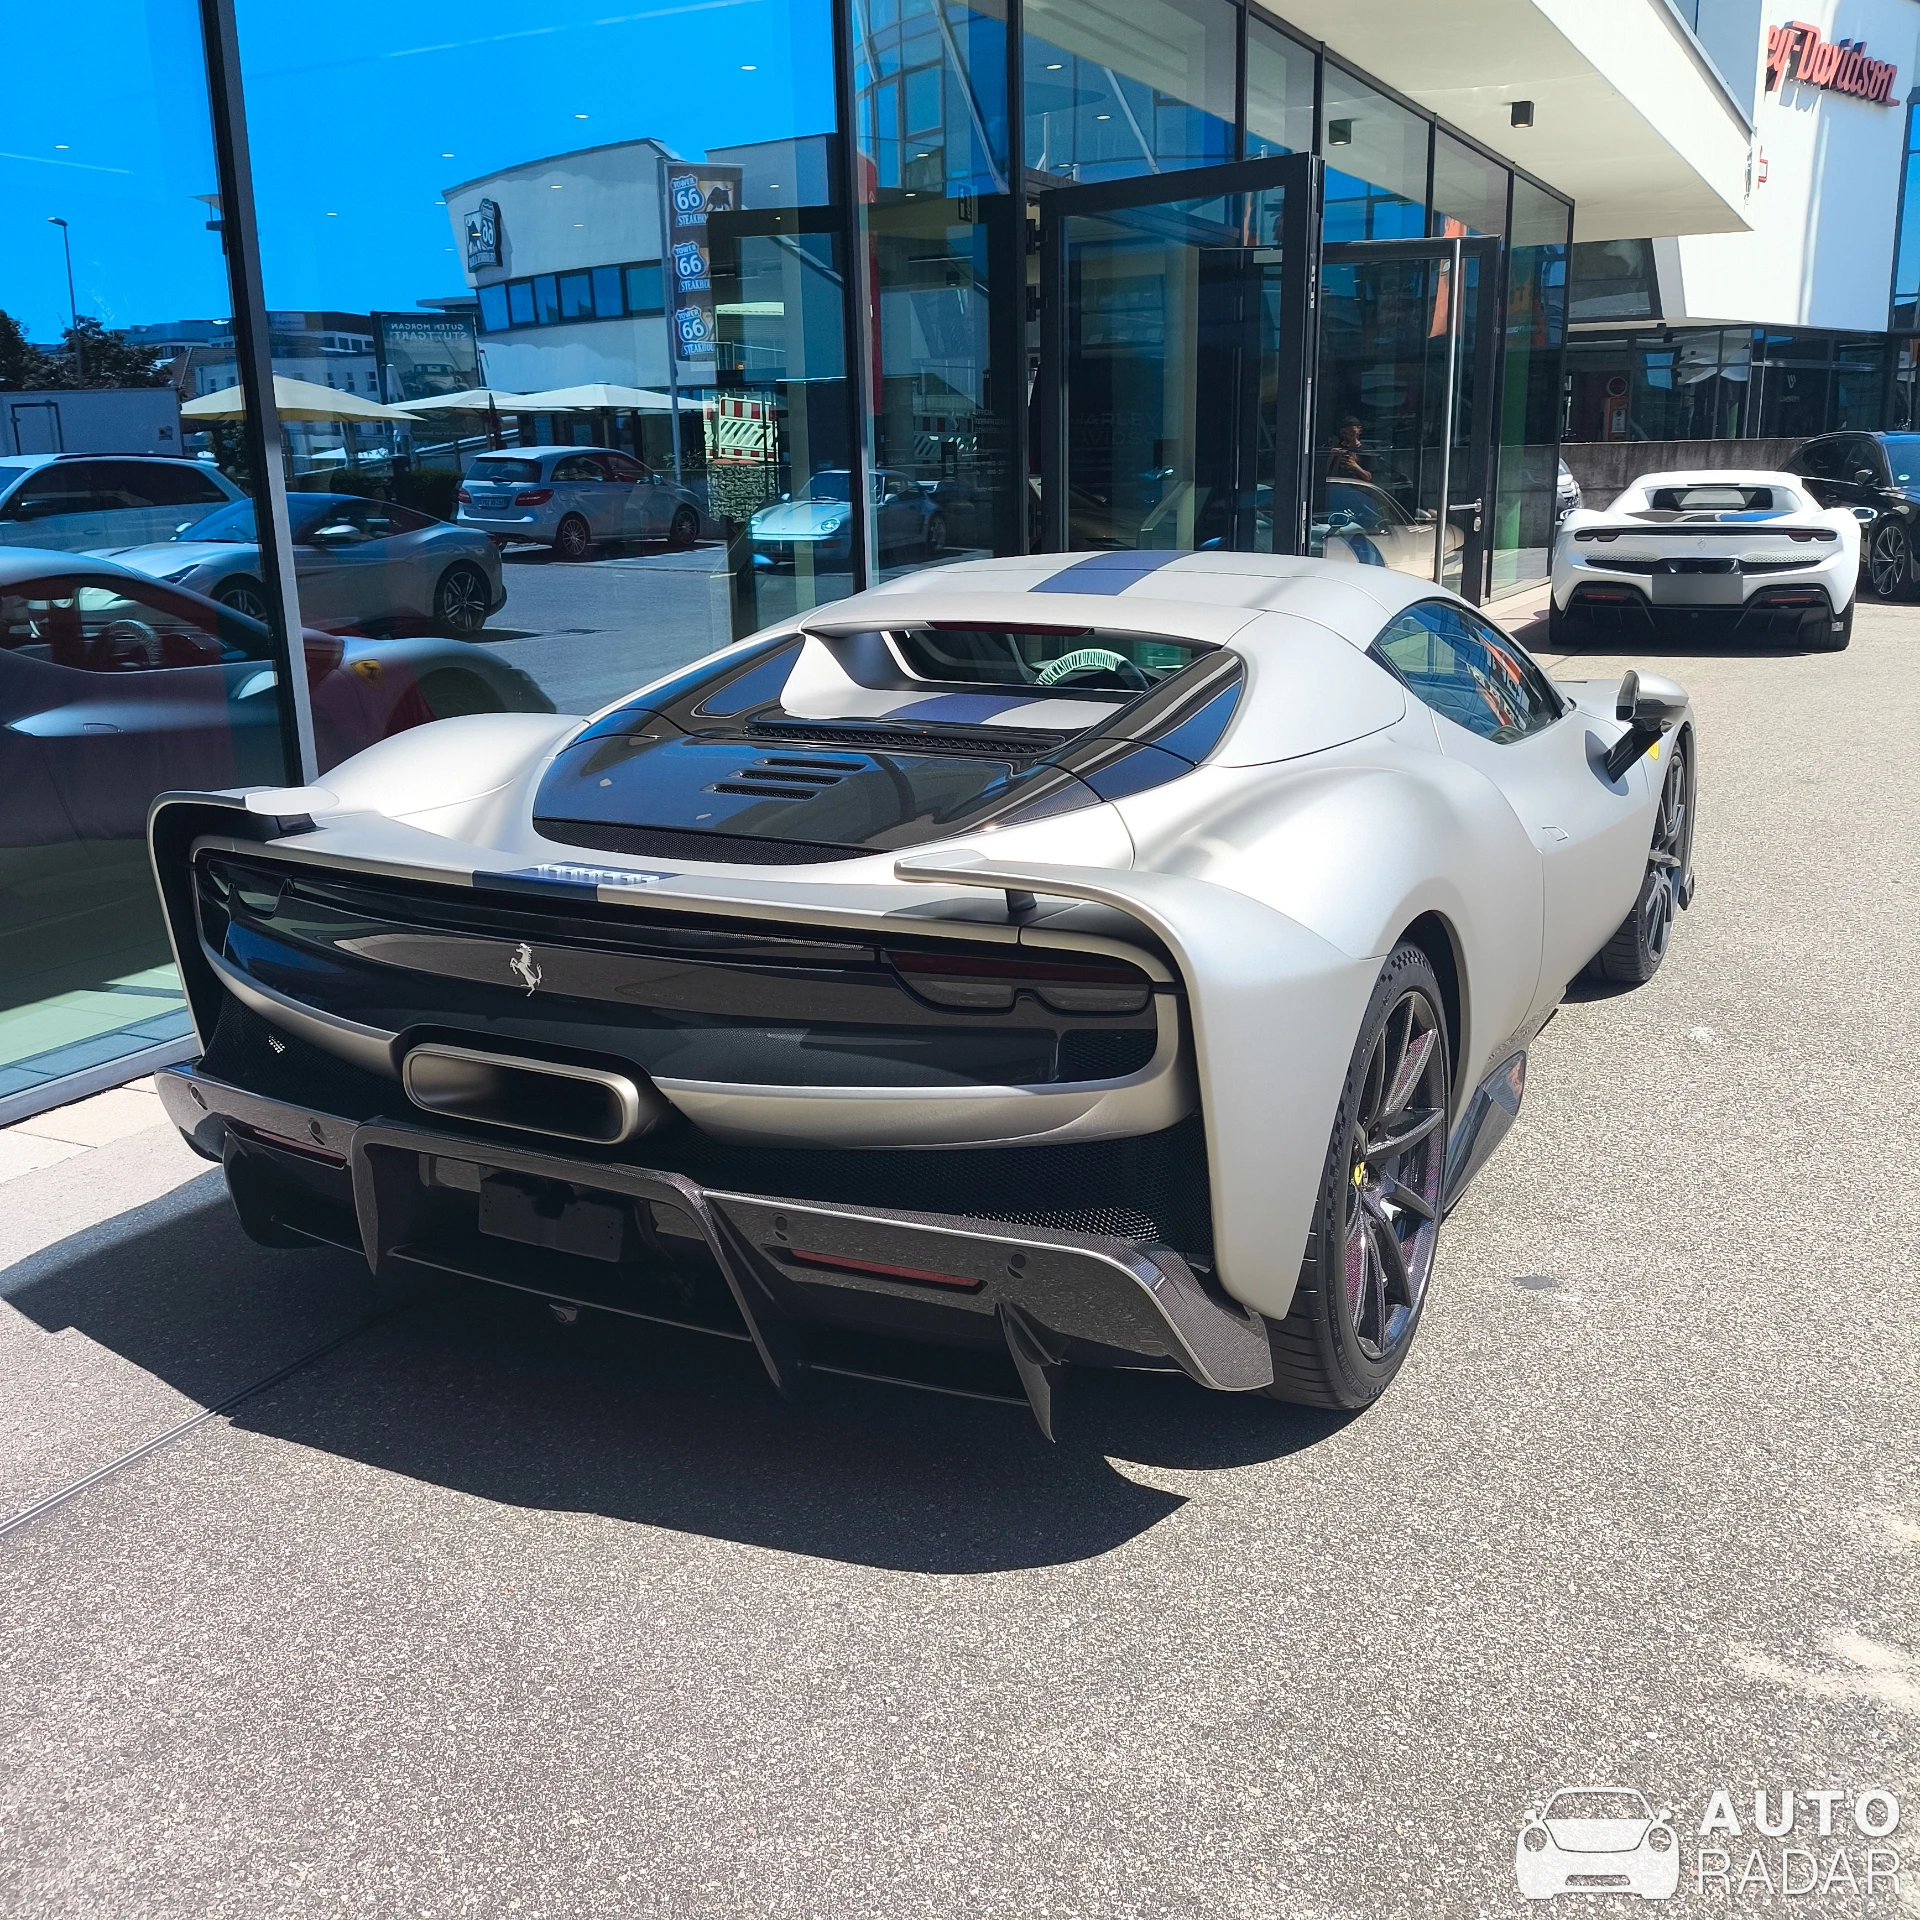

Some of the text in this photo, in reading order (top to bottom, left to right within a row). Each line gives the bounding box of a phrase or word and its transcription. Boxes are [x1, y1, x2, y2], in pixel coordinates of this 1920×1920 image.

[677, 188, 700, 210] 66
[678, 213, 708, 226] STEAKHO
[680, 254, 702, 276] 66
[682, 319, 705, 340] 66
